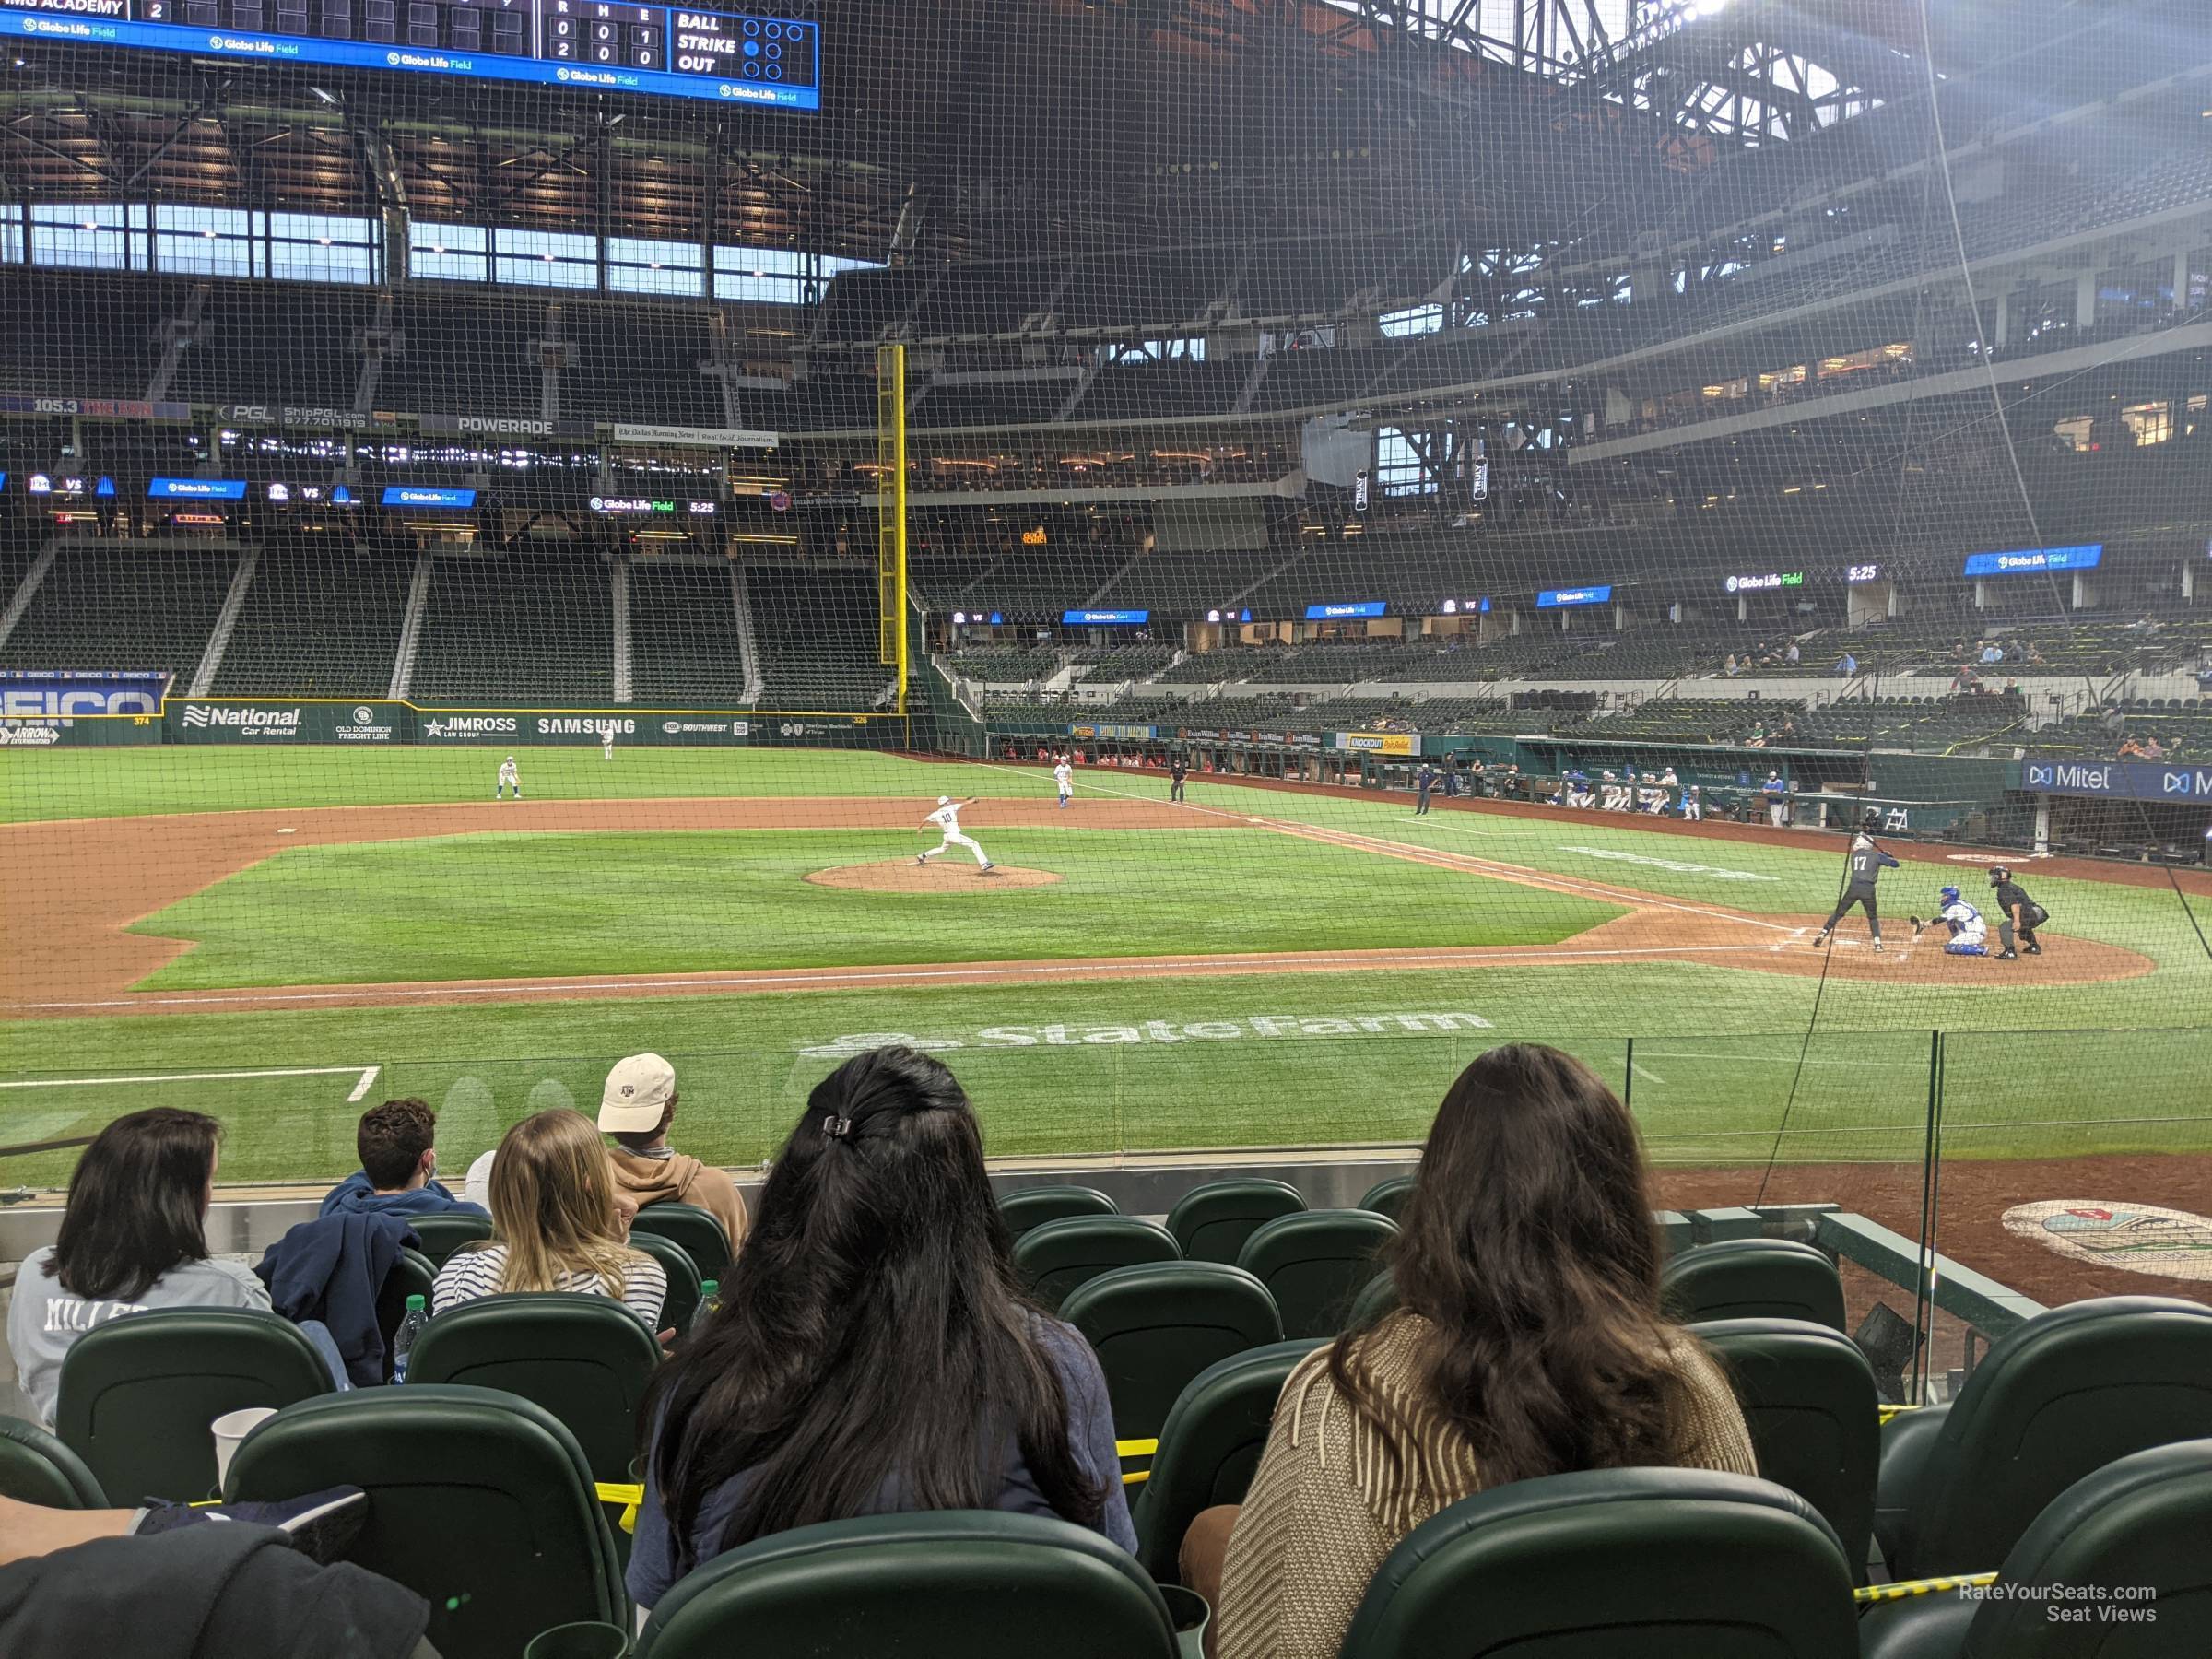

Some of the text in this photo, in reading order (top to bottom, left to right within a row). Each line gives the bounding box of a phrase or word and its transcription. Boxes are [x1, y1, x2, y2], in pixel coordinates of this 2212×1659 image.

[150, 4, 161, 18] 2
[559, 1, 649, 20] R H E
[38, 21, 115, 38] Globe Life Field
[677, 14, 719, 31] BALL
[559, 21, 649, 43] 0 0 1
[224, 39, 299, 54] Globe Life Field
[678, 35, 735, 53] STRIKE
[559, 43, 650, 64] 2 0 0
[401, 54, 472, 70] Globe Life Field
[678, 56, 715, 72] OUT
[570, 70, 638, 86] Globe Life Field
[732, 87, 796, 101] Globe Life Field
[34, 399, 77, 413] 105.3
[233, 406, 275, 420] PGL
[458, 418, 553, 435] POWERADE
[631, 428, 651, 437] Dallas
[652, 429, 677, 439] Morning
[177, 484, 197, 492] Globe
[198, 484, 210, 492] Life
[409, 492, 429, 500] Globe
[604, 499, 673, 511] Globe Life Field
[689, 502, 714, 512] 5:25
[1738, 572, 1803, 588] Globe Life Field
[1849, 566, 1876, 581] 5:25
[0, 691, 155, 727] EICO
[134, 717, 149, 726] 374
[537, 718, 635, 734] SAMSUNG
[682, 724, 727, 732] SOUTHWEST
[13, 727, 50, 738] ARROW
[241, 726, 296, 735] Car Rental
[1351, 737, 1382, 748] KNOCKOUT
[2057, 765, 2110, 790] Mitel
[942, 813, 952, 824] 10
[1853, 856, 1867, 871] 17
